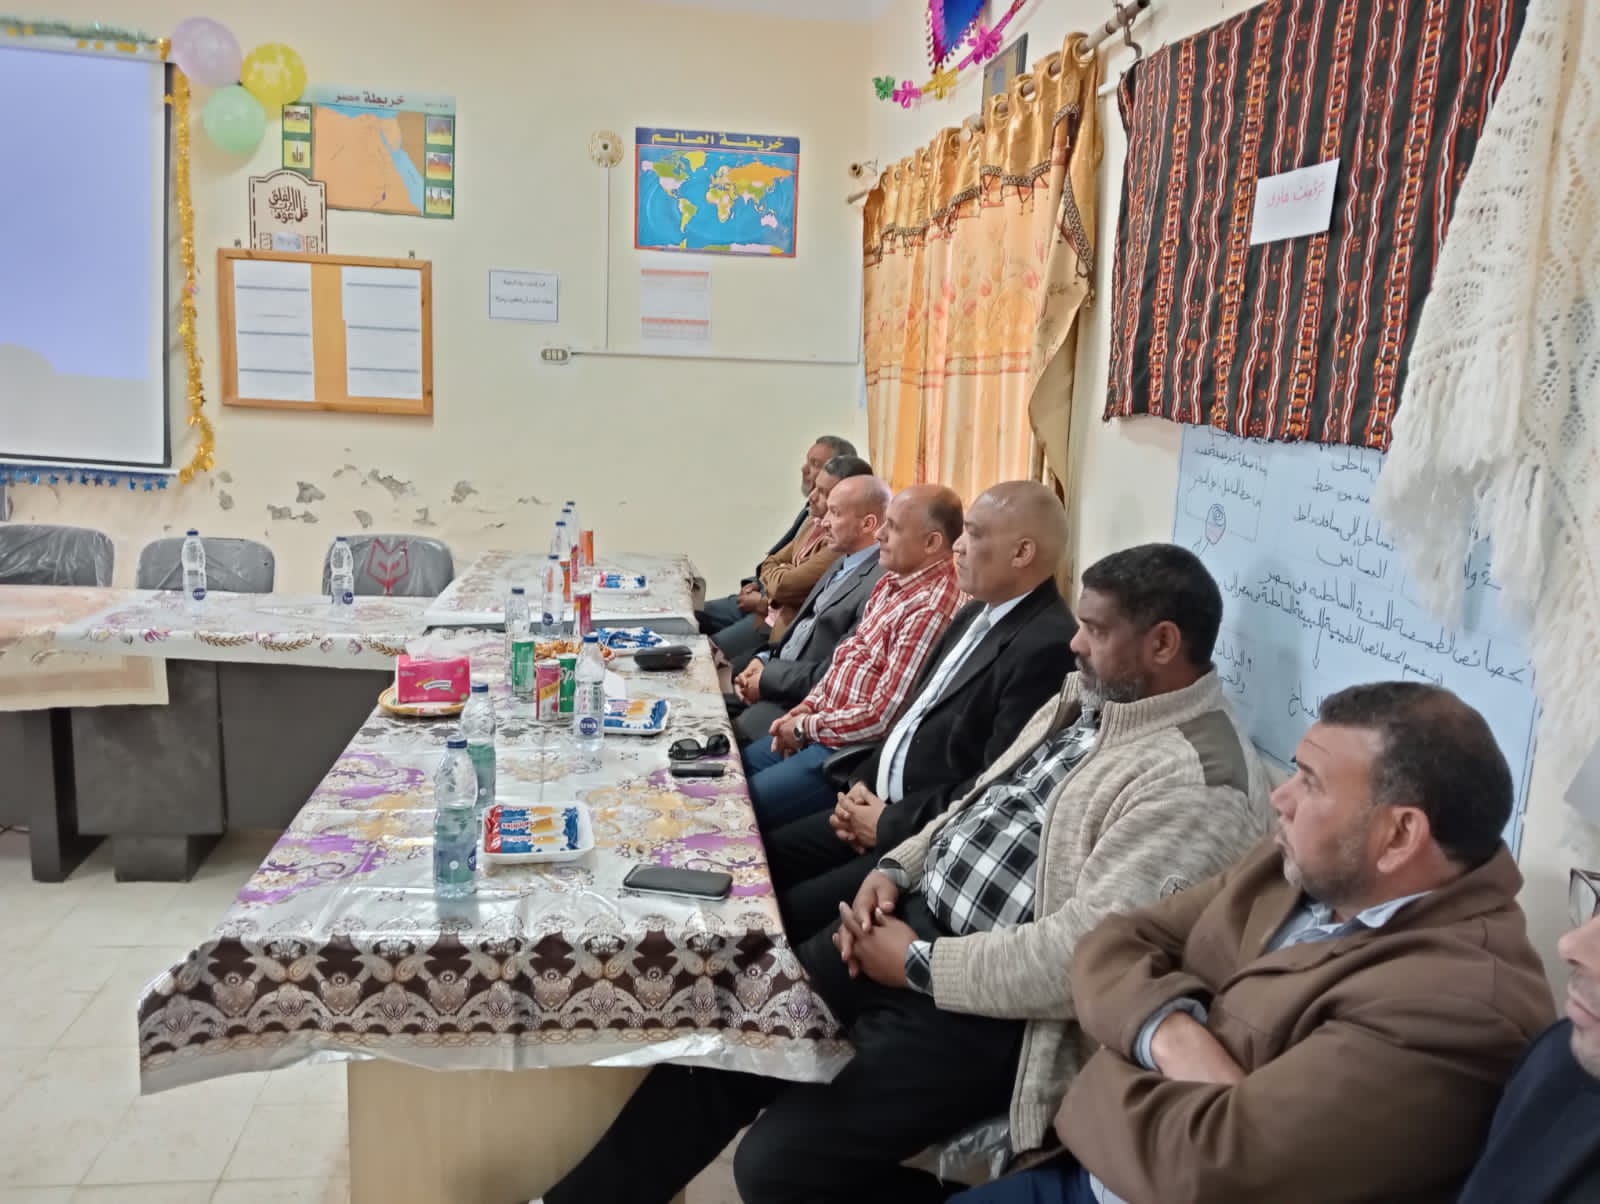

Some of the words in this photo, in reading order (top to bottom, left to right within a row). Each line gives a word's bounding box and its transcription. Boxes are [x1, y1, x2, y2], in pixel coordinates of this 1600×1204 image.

[335, 93, 360, 103] مصر
[362, 90, 405, 107] خريطة
[652, 131, 715, 145] العالم
[720, 132, 785, 151] خريطة
